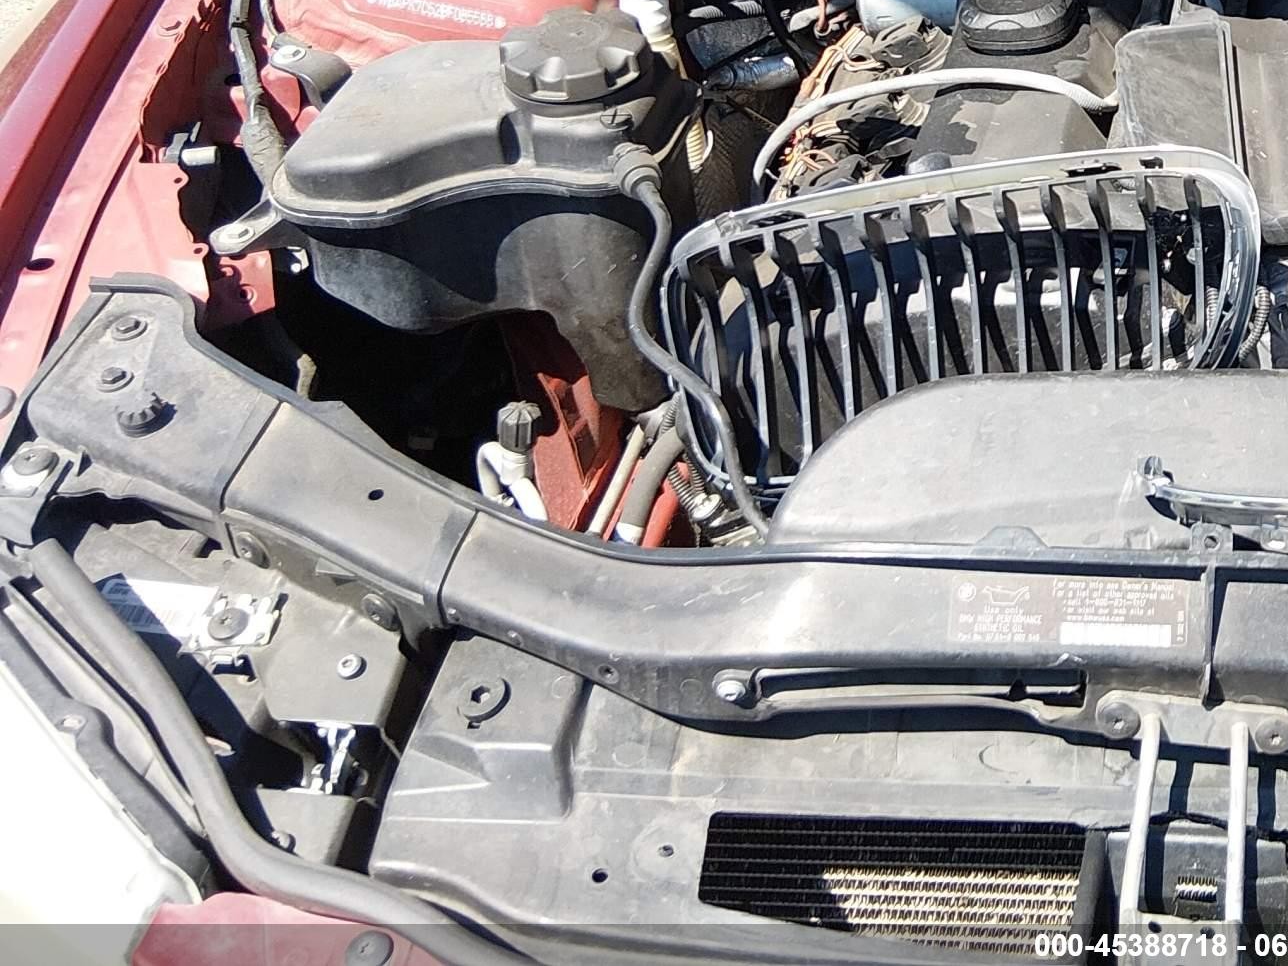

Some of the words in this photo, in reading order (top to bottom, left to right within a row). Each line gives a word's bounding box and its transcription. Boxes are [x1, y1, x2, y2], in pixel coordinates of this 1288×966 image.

[984, 603, 1000, 614] Use
[1005, 605, 1024, 616] only
[996, 614, 1043, 625] PERFORMANCE
[1012, 623, 1024, 633] OIL
